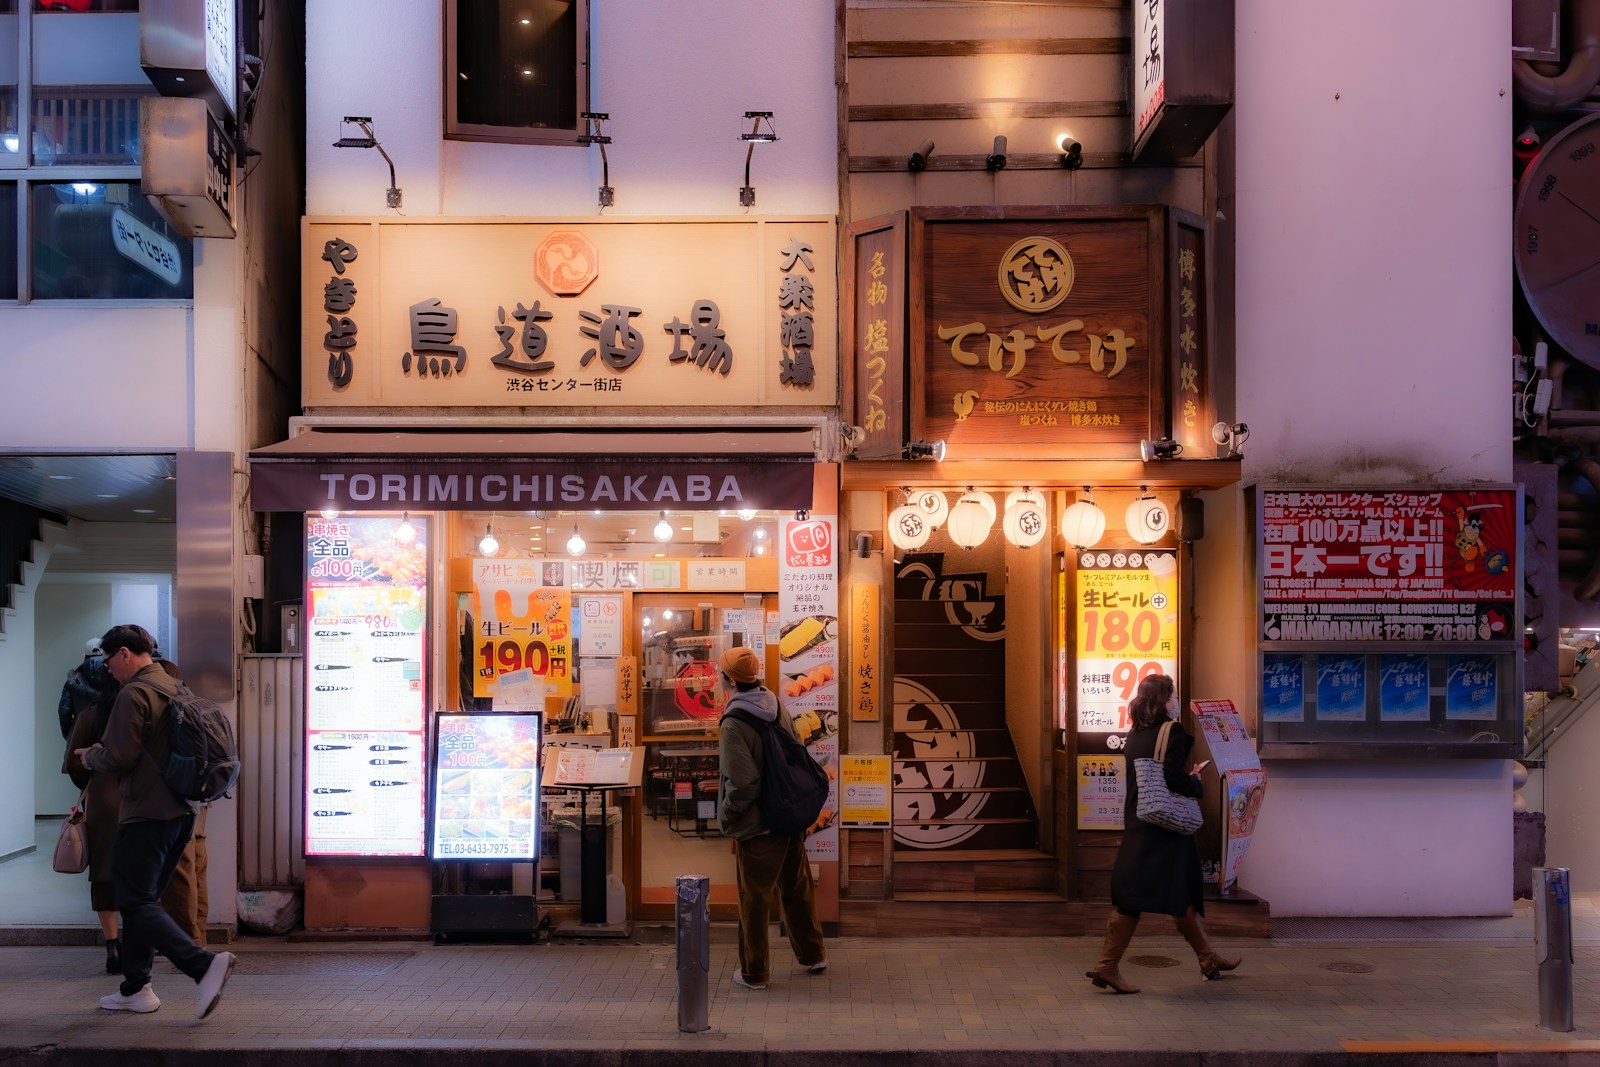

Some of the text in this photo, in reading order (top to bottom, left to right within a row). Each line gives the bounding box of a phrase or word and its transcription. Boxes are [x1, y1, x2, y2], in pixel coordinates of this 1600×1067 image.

[1569, 142, 1595, 163] 1999
[1538, 174, 1557, 202] 1998
[1527, 224, 1540, 255] 1997
[321, 237, 358, 386] やきとり
[779, 235, 815, 386] 大衆酒場
[402, 298, 733, 376] 鳥道酒場
[864, 251, 890, 433] 名物 塩つくね
[1179, 248, 1200, 428] 博多水炊き
[938, 319, 1136, 379] てけてけ
[506, 378, 622, 392] 渋谷センター街店
[1019, 414, 1121, 426] 塩つくね 博多水炊き
[320, 473, 745, 503] TORIMICHISAKABA
[1264, 493, 1443, 507] 日本最大のコレクターズショップ
[313, 524, 349, 536] 串焼き
[314, 539, 349, 557] 全品
[1264, 543, 1444, 577] 日本一です!!
[479, 564, 513, 578] アサヒ
[695, 568, 738, 576] 営業時間
[1264, 579, 1279, 588] THE
[1280, 579, 1315, 588] BIGGEST
[1316, 579, 1374, 588] ANIME-MANGA
[1375, 579, 1397, 588] SHOP
[1399, 579, 1409, 588] OF
[1083, 589, 1150, 608] 生ビール
[1264, 589, 1281, 598] SALE
[1282, 590, 1287, 598] &
[1288, 589, 1325, 598] BUY-BACK
[792, 605, 825, 613] 玉子焼き
[1265, 604, 1476, 614] WELCOME TO MANDARAKE! COME DOWNSTAIRS B2F
[482, 621, 544, 637] 生ビール
[1084, 610, 1161, 652] 180
[1281, 620, 1383, 640] MANDARAKE
[480, 640, 549, 679] 190
[621, 666, 632, 703] 営業中
[1081, 673, 1111, 684] お料理
[858, 664, 873, 713] 焼き鶏
[446, 723, 475, 733] 串焼き
[445, 735, 475, 750] 全品
